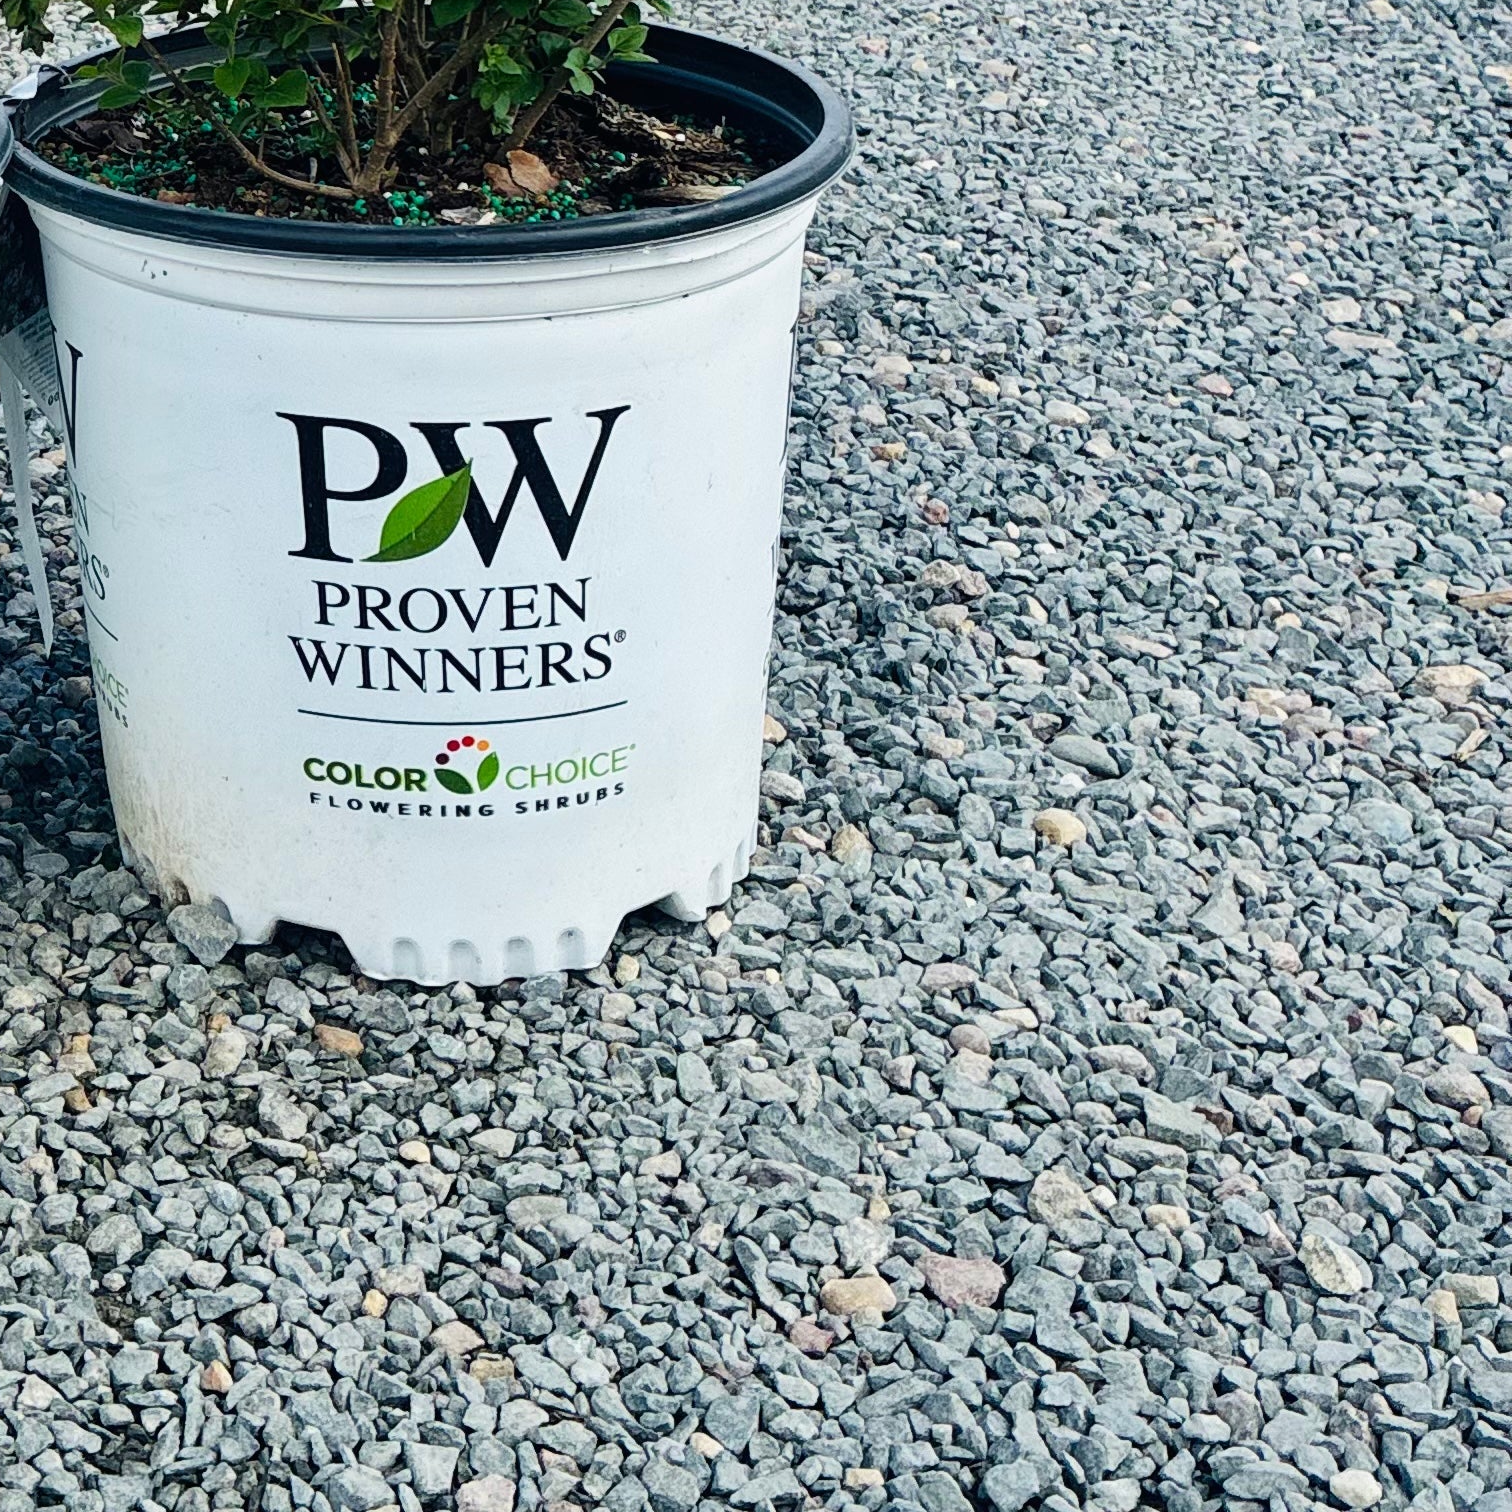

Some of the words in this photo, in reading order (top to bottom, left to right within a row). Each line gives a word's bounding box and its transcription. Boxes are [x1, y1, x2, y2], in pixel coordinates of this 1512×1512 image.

[276, 405, 631, 568] PW
[312, 577, 592, 633] PROVEN
[303, 757, 428, 792] COLOR
[310, 792, 496, 817] FLOWERING
[515, 783, 626, 815] SHRUBS
